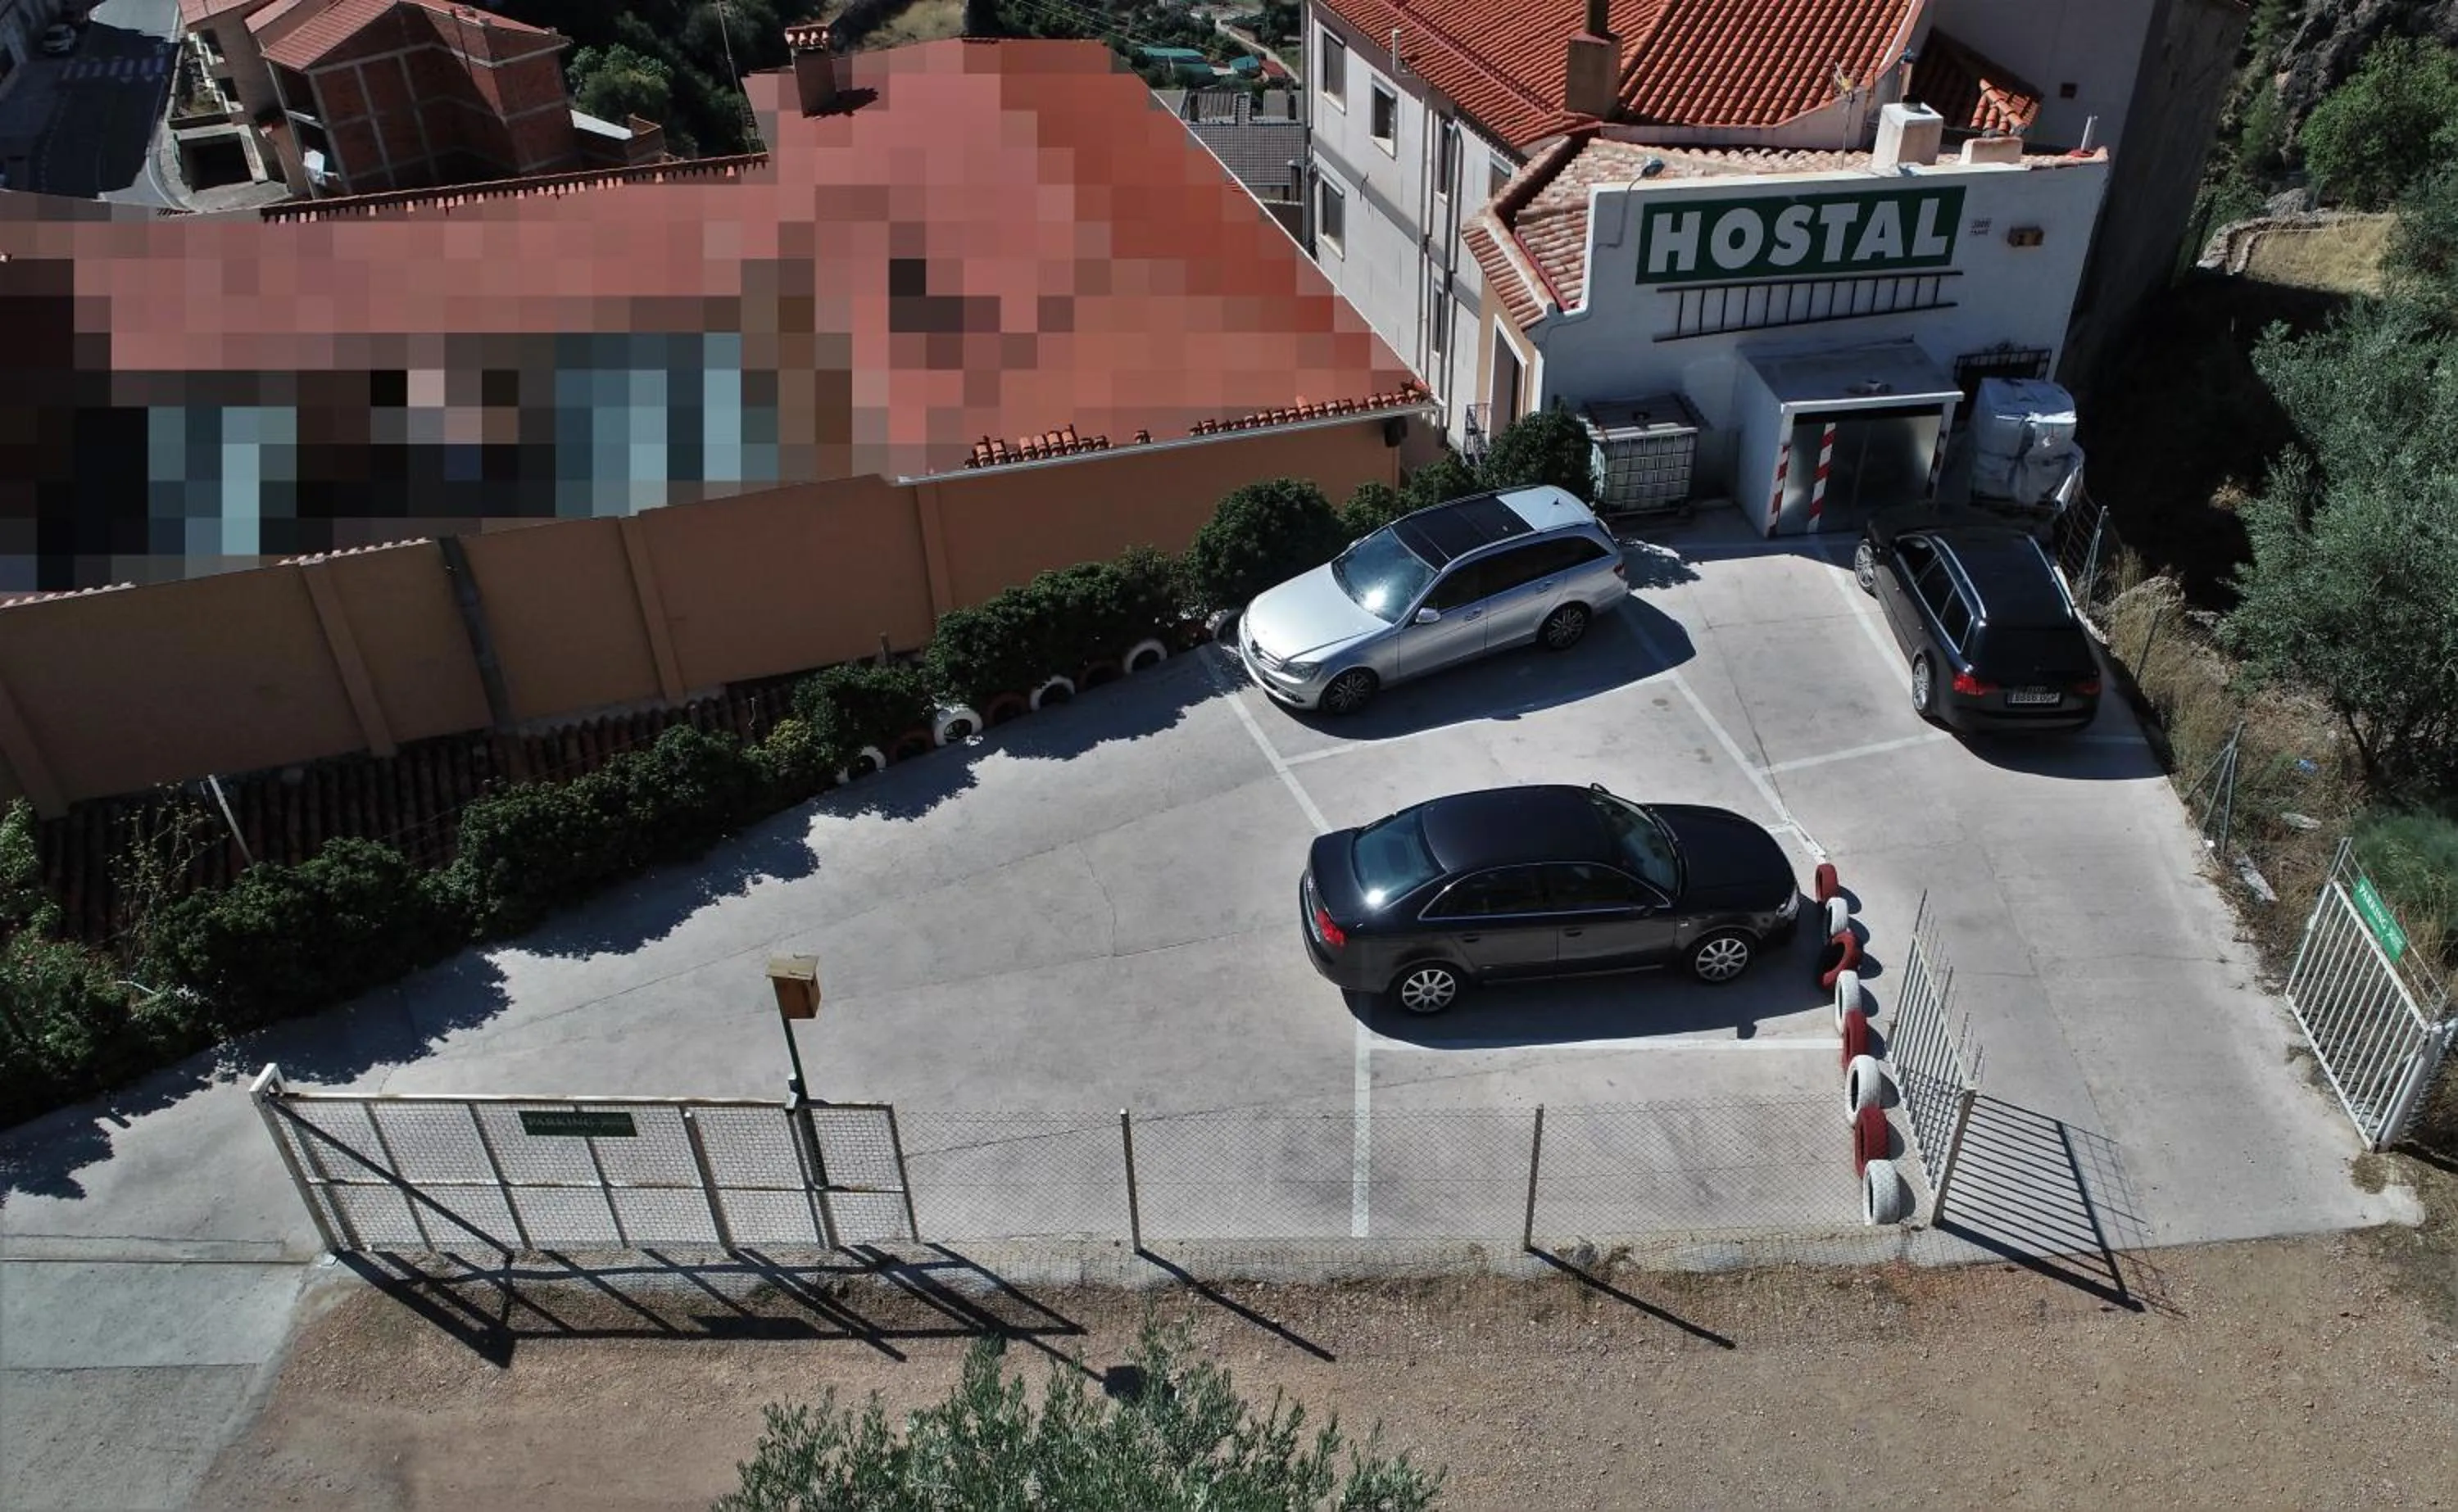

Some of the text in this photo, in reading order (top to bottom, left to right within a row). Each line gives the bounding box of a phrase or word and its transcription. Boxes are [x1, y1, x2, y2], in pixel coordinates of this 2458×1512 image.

[1648, 197, 1950, 273] HOSTAL
[2359, 884, 2388, 930] PARKING
[524, 1116, 593, 1128] PARKING
